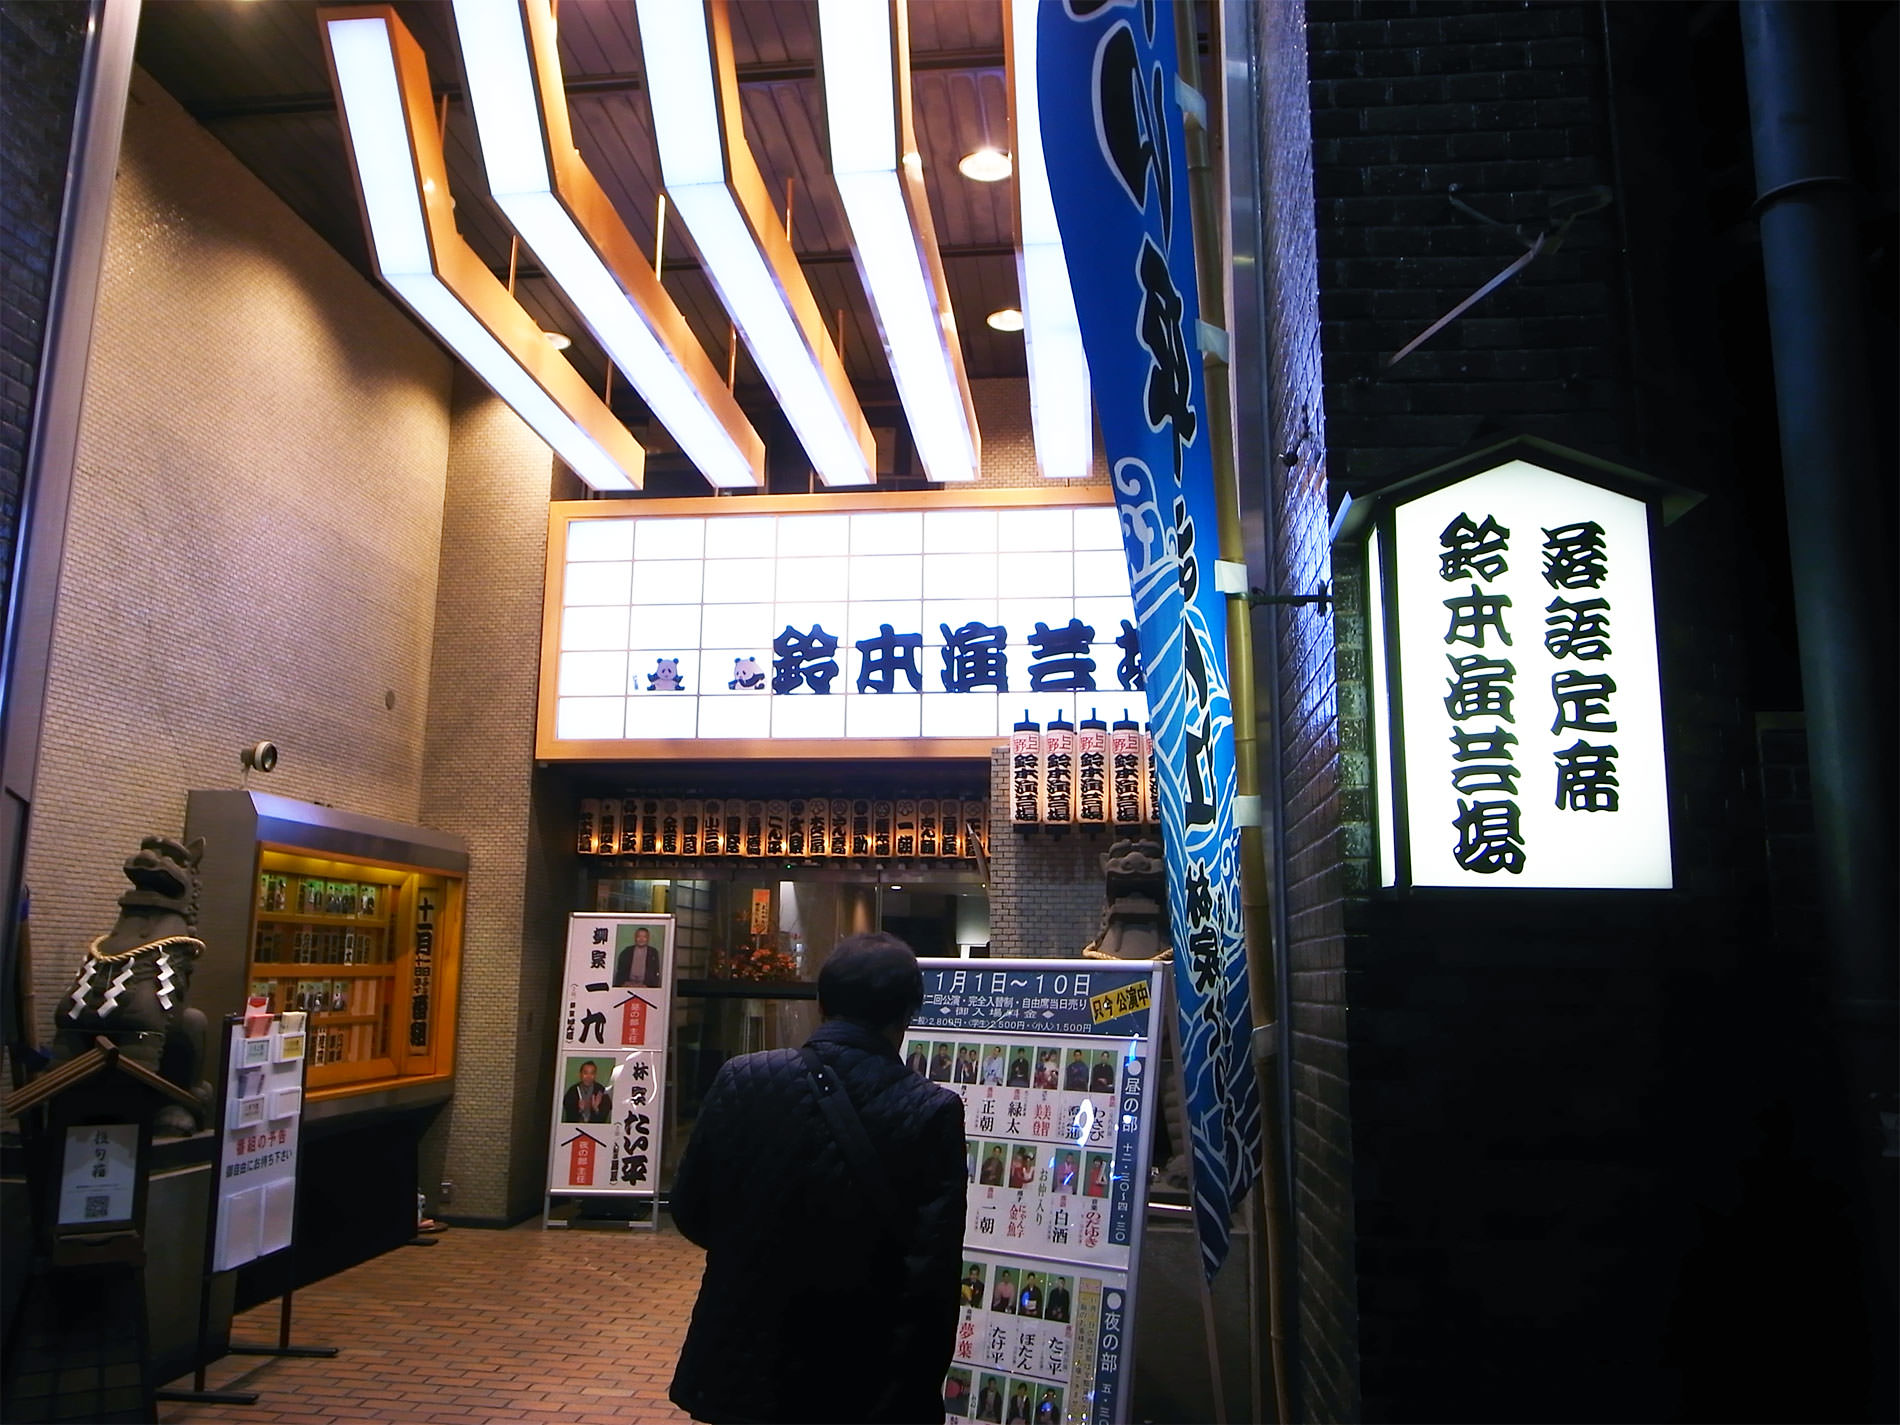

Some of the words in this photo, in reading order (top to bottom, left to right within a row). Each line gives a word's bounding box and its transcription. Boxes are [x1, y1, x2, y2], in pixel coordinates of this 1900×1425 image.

[1439, 511, 1527, 875] 鈴本演芸場
[1541, 520, 1620, 813] 落語定席
[1014, 753, 1039, 822] 鈴本演芸場
[1047, 753, 1072, 822] 鈴本演芸場
[1080, 752, 1105, 821] 鈴本演芸場
[1114, 754, 1139, 822] 鈴本演芸場
[922, 970, 1091, 996] 1月1日～10日
[980, 1098, 996, 1133] 正朝
[1006, 1101, 1022, 1134] 緑太
[980, 1205, 997, 1235] 一朝
[1052, 1209, 1068, 1245] 白酒
[957, 1322, 975, 1359] 夢葉
[1101, 1312, 1121, 1374] 夜の部
